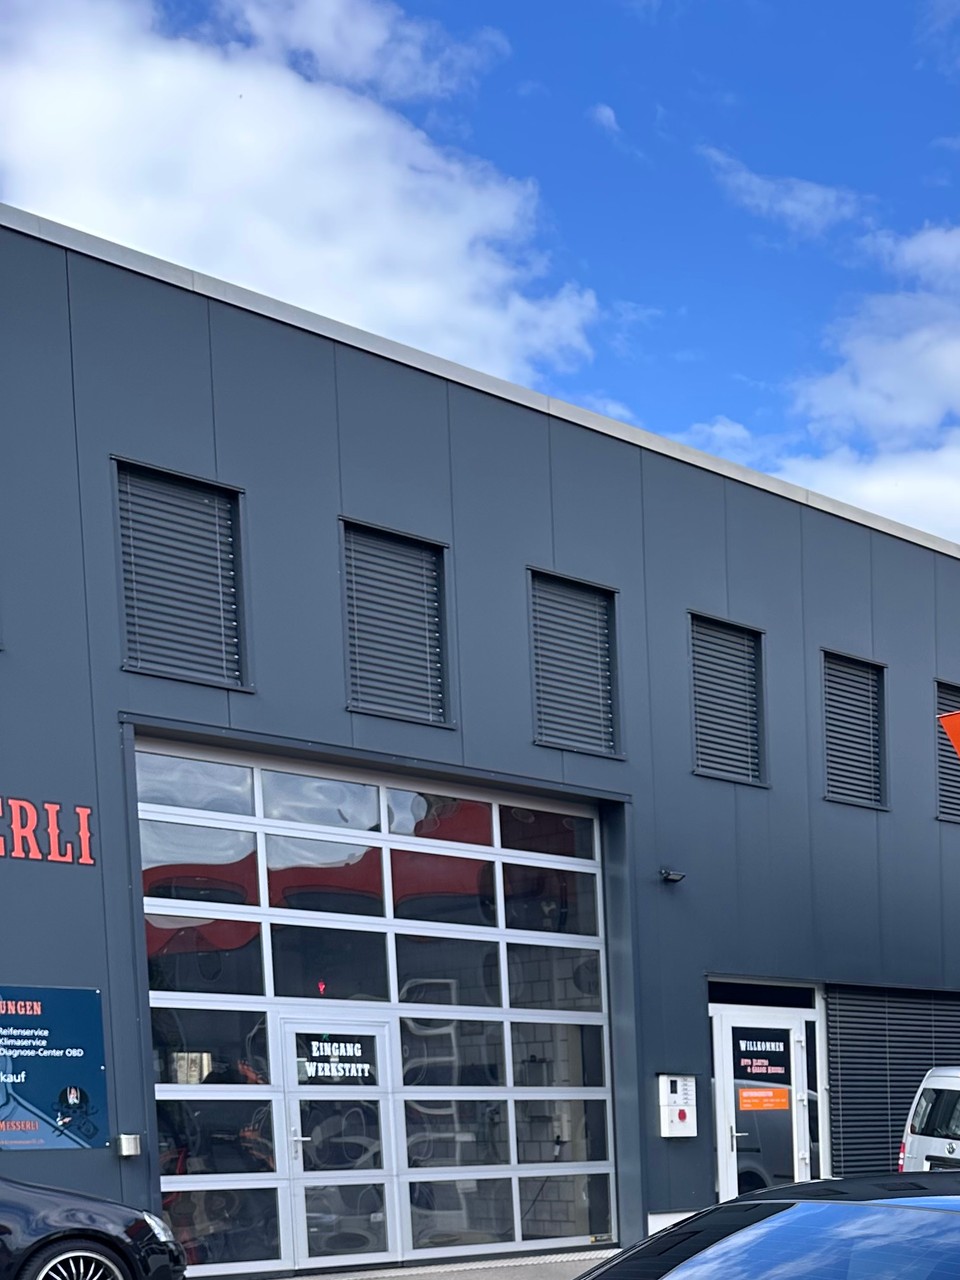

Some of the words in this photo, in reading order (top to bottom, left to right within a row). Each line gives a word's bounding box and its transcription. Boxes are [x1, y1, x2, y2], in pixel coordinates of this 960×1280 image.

[0, 797, 95, 865] RLI
[65, 1048, 84, 1057] OBD
[311, 1041, 362, 1057] EINGANG
[304, 1061, 370, 1077] WERKSTATT
